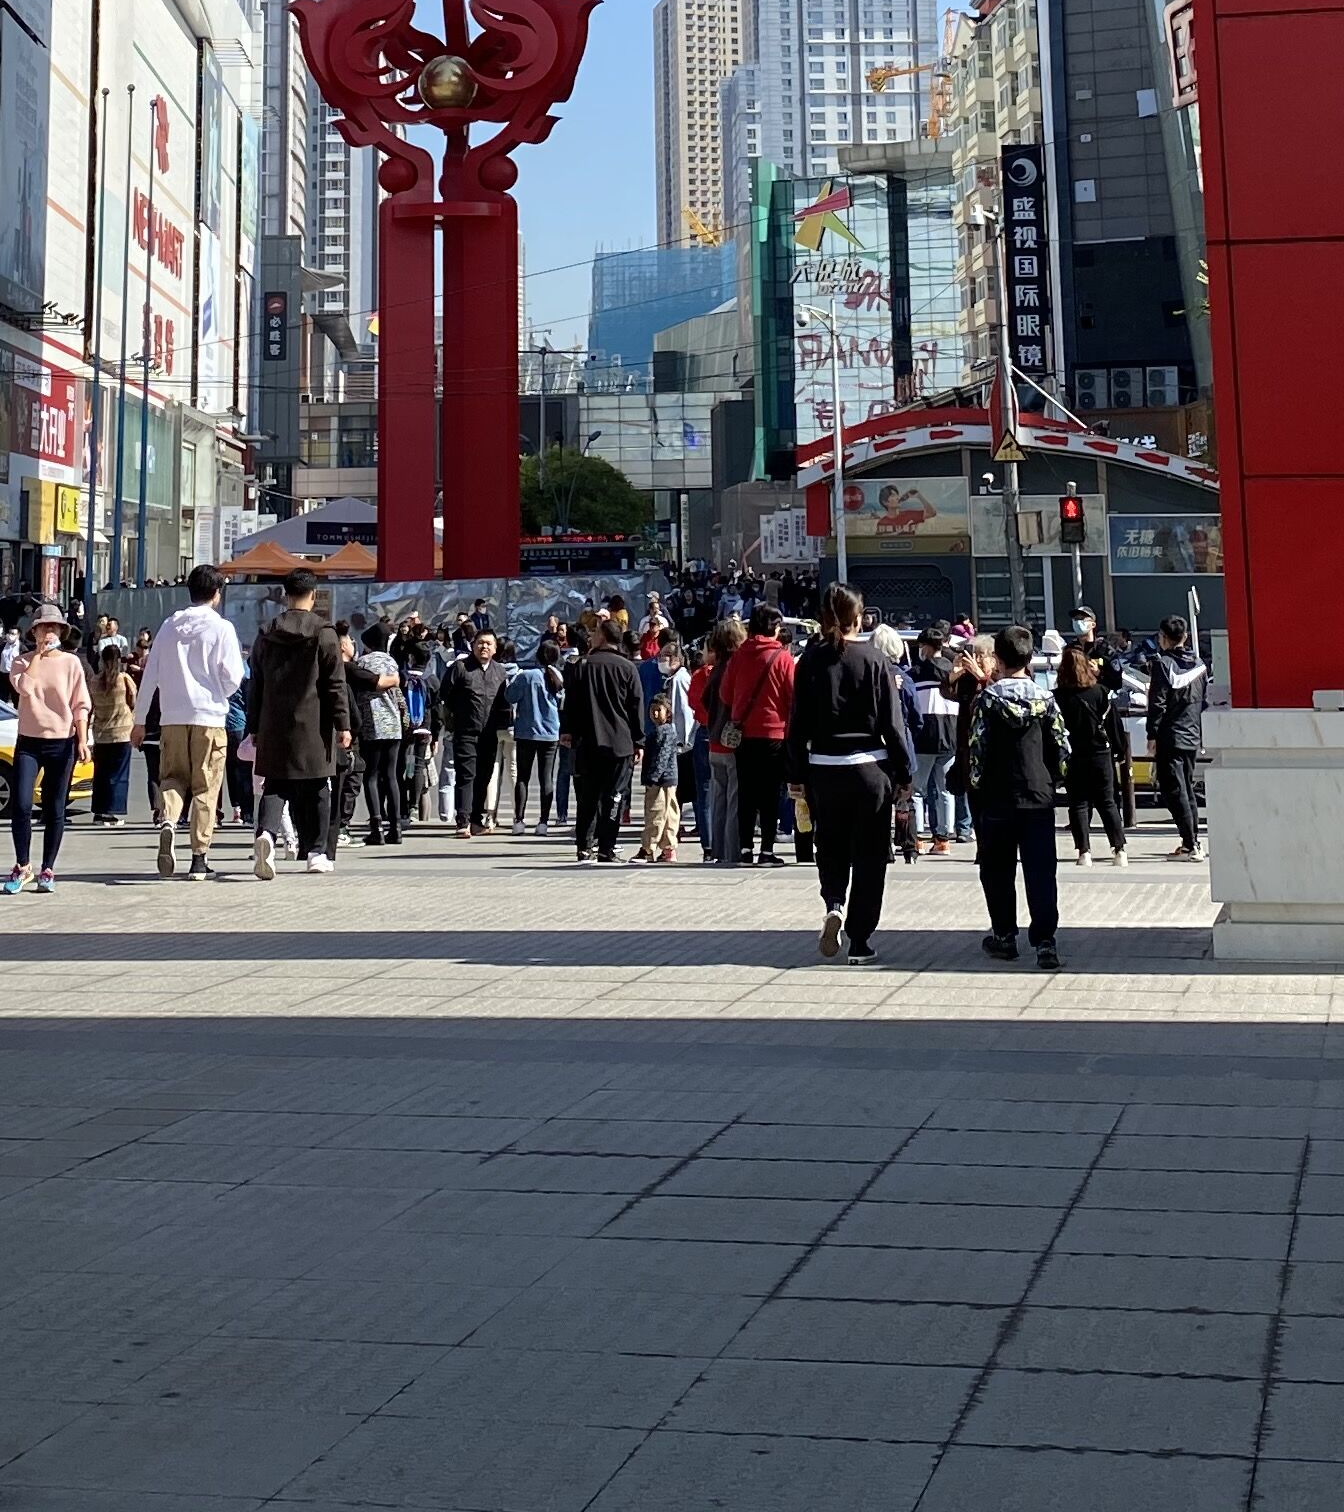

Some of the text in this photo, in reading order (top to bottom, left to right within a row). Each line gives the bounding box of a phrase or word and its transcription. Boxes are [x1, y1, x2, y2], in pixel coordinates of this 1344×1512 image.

[1011, 196, 1043, 367] 盛视国际眼镜
[268, 315, 282, 356] 必胜客
[1123, 529, 1156, 546] 无糖
